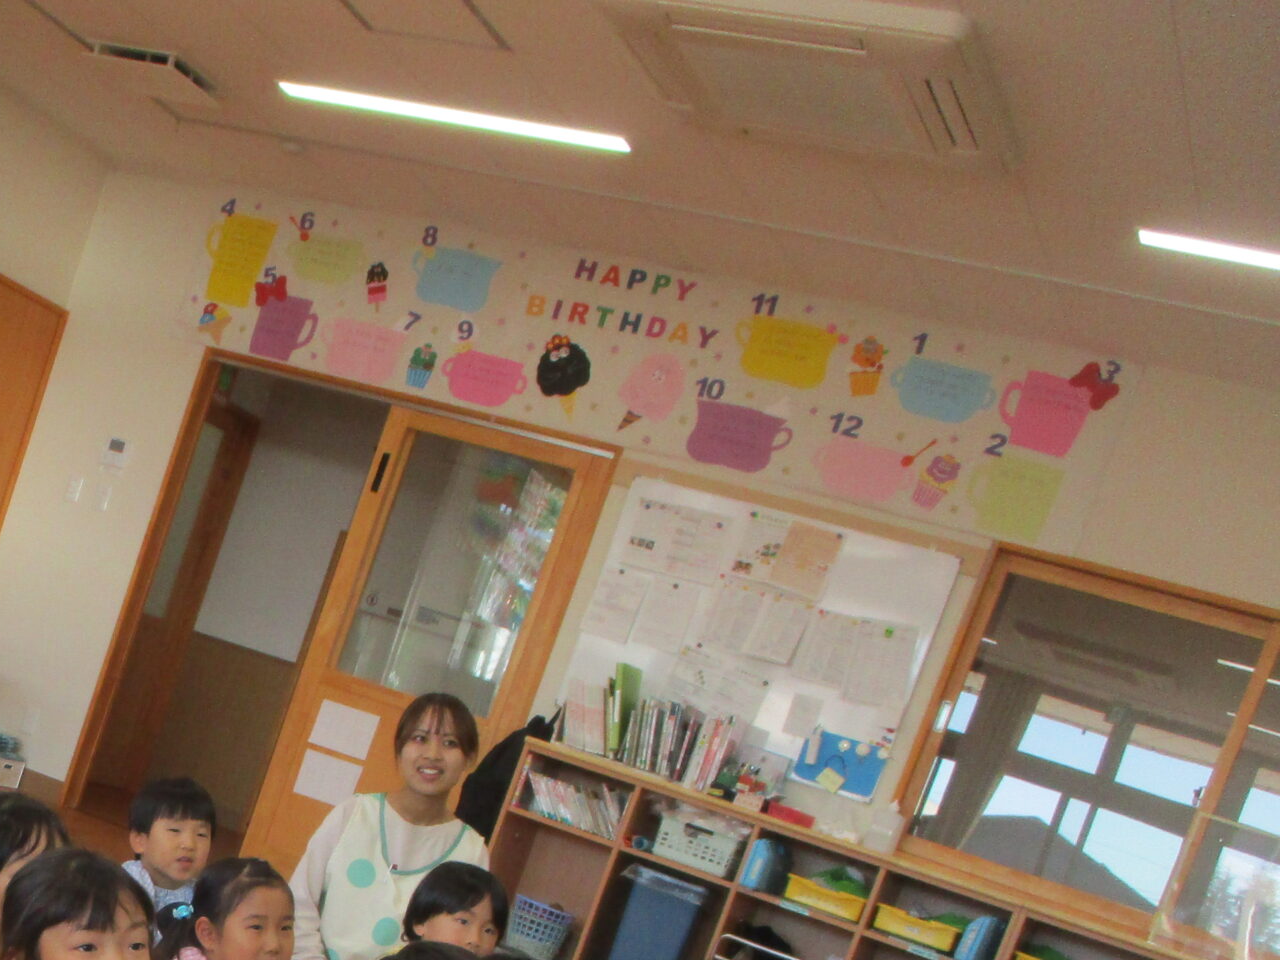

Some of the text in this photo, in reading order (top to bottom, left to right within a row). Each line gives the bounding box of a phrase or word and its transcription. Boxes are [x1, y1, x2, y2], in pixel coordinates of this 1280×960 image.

[221, 198, 236, 217] 4
[300, 212, 315, 231] 6
[422, 225, 438, 246] 8
[263, 266, 278, 286] 5
[574, 257, 697, 302] HAPPY
[751, 293, 779, 316] 11
[403, 312, 422, 331] 7
[457, 320, 474, 340] 9
[526, 294, 719, 350] BIRTHDAY
[911, 332, 929, 354] 1
[1099, 360, 1121, 384] 3
[695, 377, 725, 400] 10
[829, 412, 864, 438] 12
[984, 433, 1009, 457] 2
